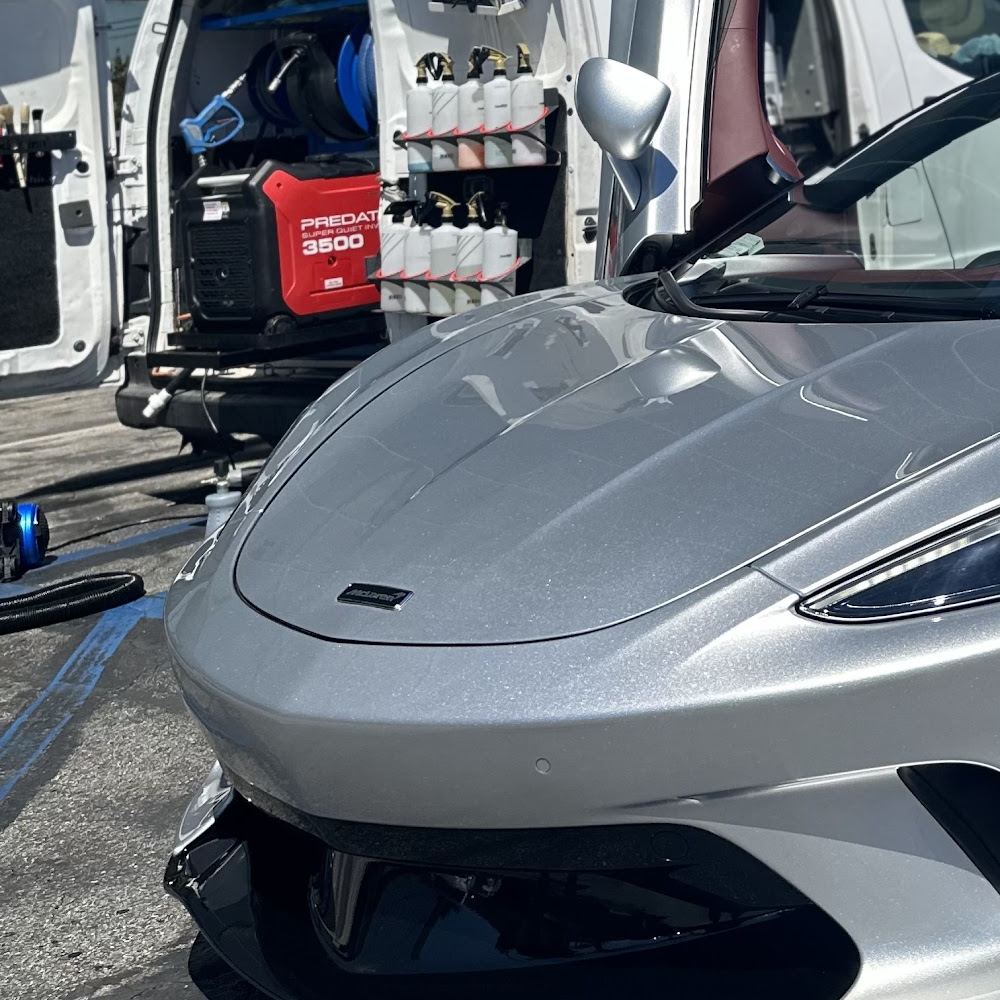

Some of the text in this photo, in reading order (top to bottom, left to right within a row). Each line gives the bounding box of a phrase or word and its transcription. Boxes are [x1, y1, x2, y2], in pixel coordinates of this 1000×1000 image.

[302, 229, 334, 239] SUPER
[336, 225, 364, 235] QUIET
[302, 233, 364, 256] 3500
[346, 588, 401, 602] McLaren
